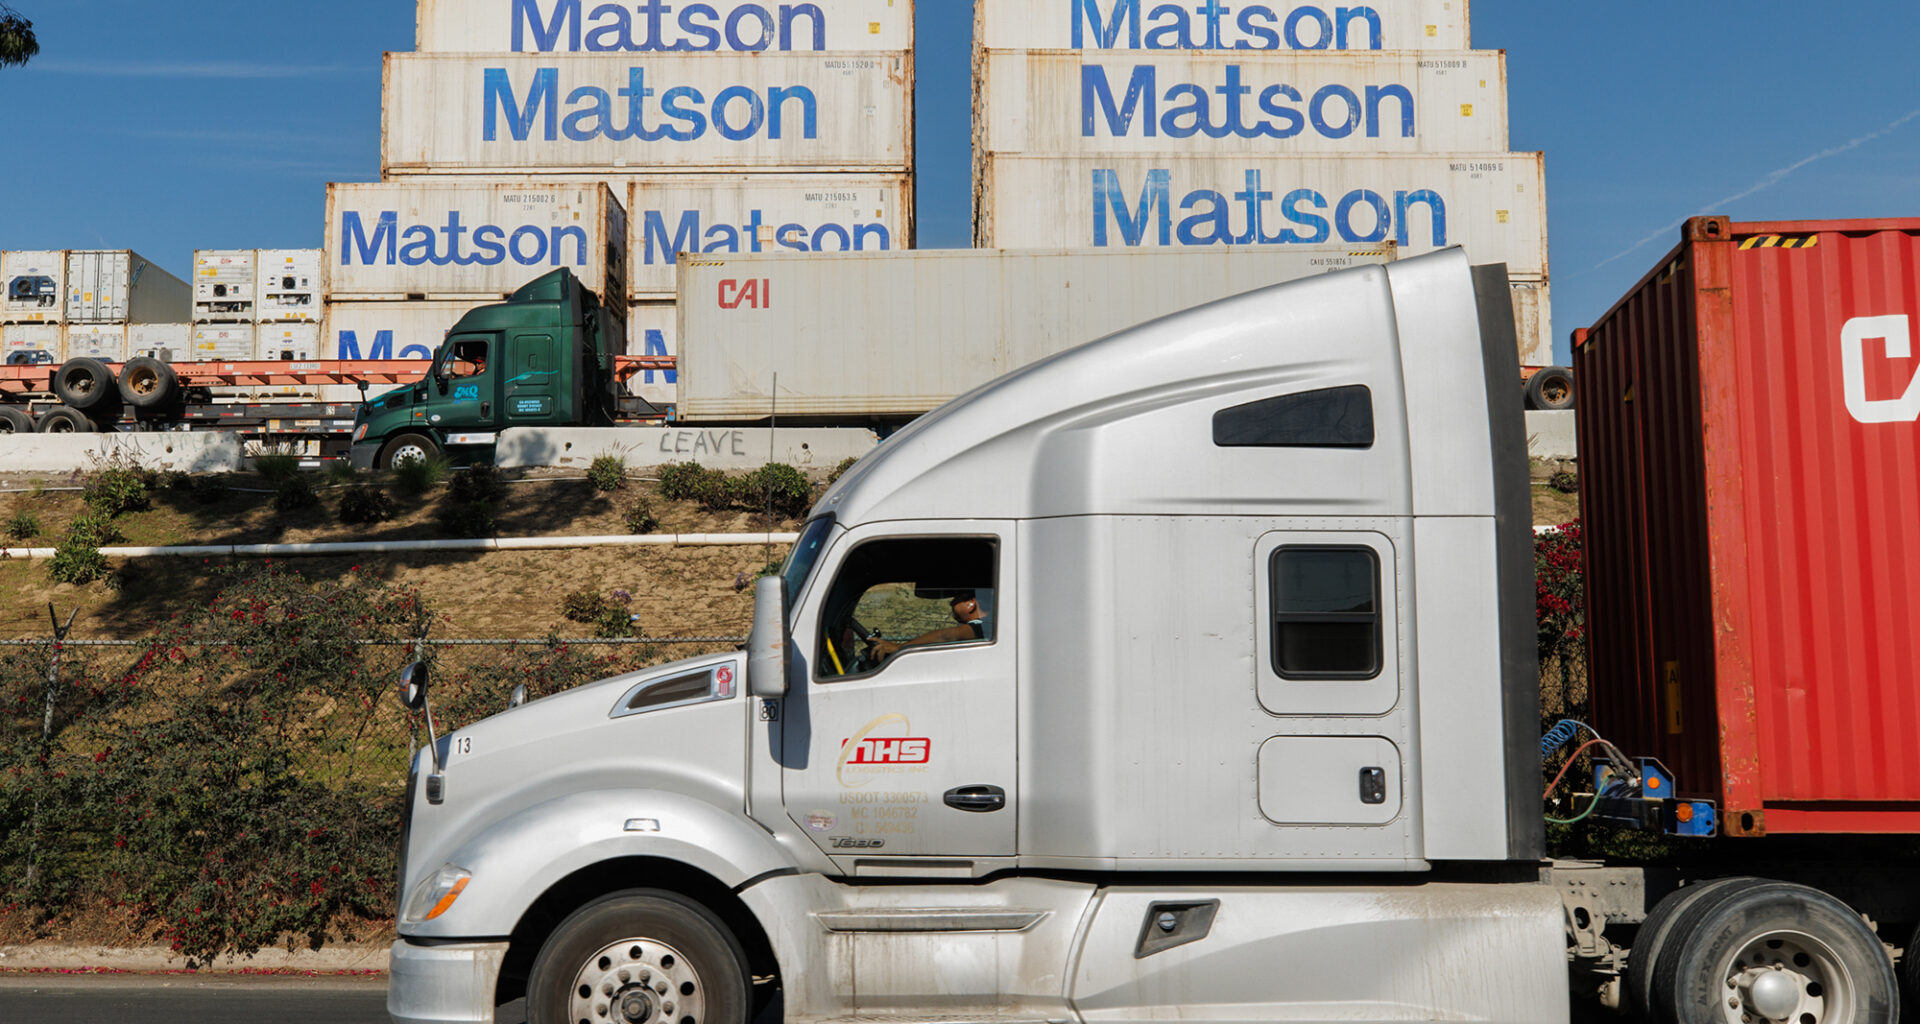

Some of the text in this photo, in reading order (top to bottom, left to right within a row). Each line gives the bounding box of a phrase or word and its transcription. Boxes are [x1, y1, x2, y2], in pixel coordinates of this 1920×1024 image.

[512, 0, 825, 51] Matson
[1071, 0, 1382, 49] Matson
[824, 60, 841, 69] MATU
[1417, 60, 1434, 69] MATU
[484, 67, 817, 141] Matson
[1082, 65, 1415, 138] Matson
[1449, 163, 1467, 171] MATU
[503, 194, 520, 203] MATU
[804, 192, 823, 201] MATU
[1092, 169, 1447, 247] Matson
[341, 211, 587, 265] Matson
[644, 210, 890, 264] Matson
[718, 278, 770, 309] CAI
[659, 430, 746, 456] LEAVE
[761, 705, 777, 720] 80
[457, 737, 472, 754] 13
[839, 791, 880, 805] USDOT
[850, 806, 869, 819] MC
